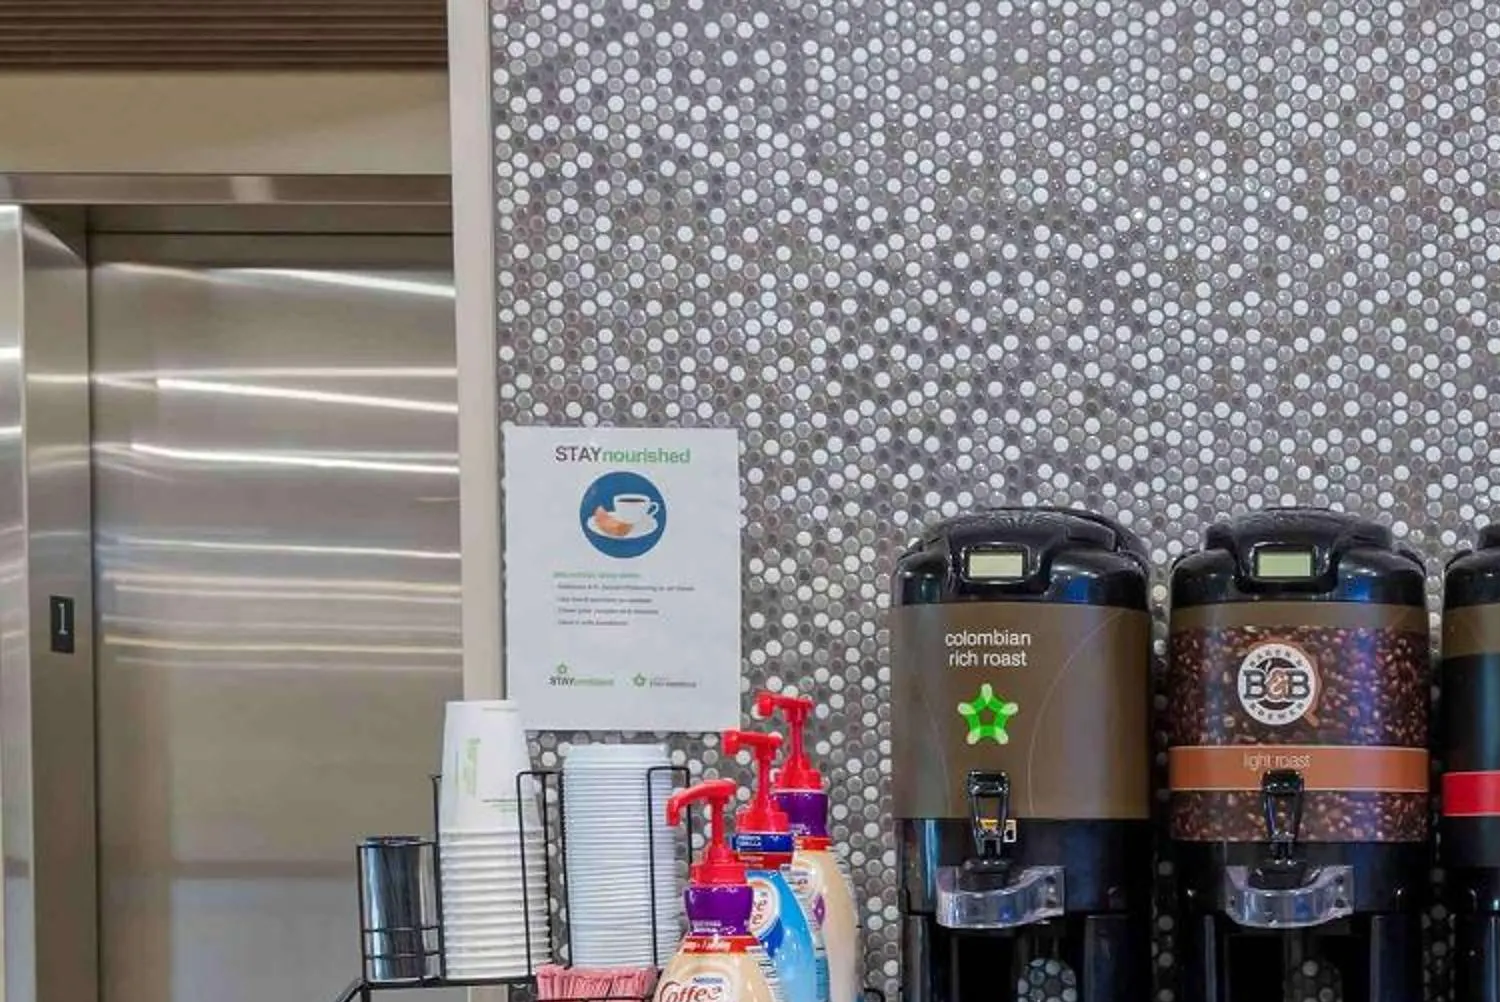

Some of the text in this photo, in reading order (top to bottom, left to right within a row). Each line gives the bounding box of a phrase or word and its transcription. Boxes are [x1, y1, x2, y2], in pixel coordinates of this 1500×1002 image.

[555, 445, 691, 463] STAYnourished
[945, 629, 1032, 646] colombian
[949, 650, 1028, 667] rich roast
[1243, 668, 1310, 701] B&B
